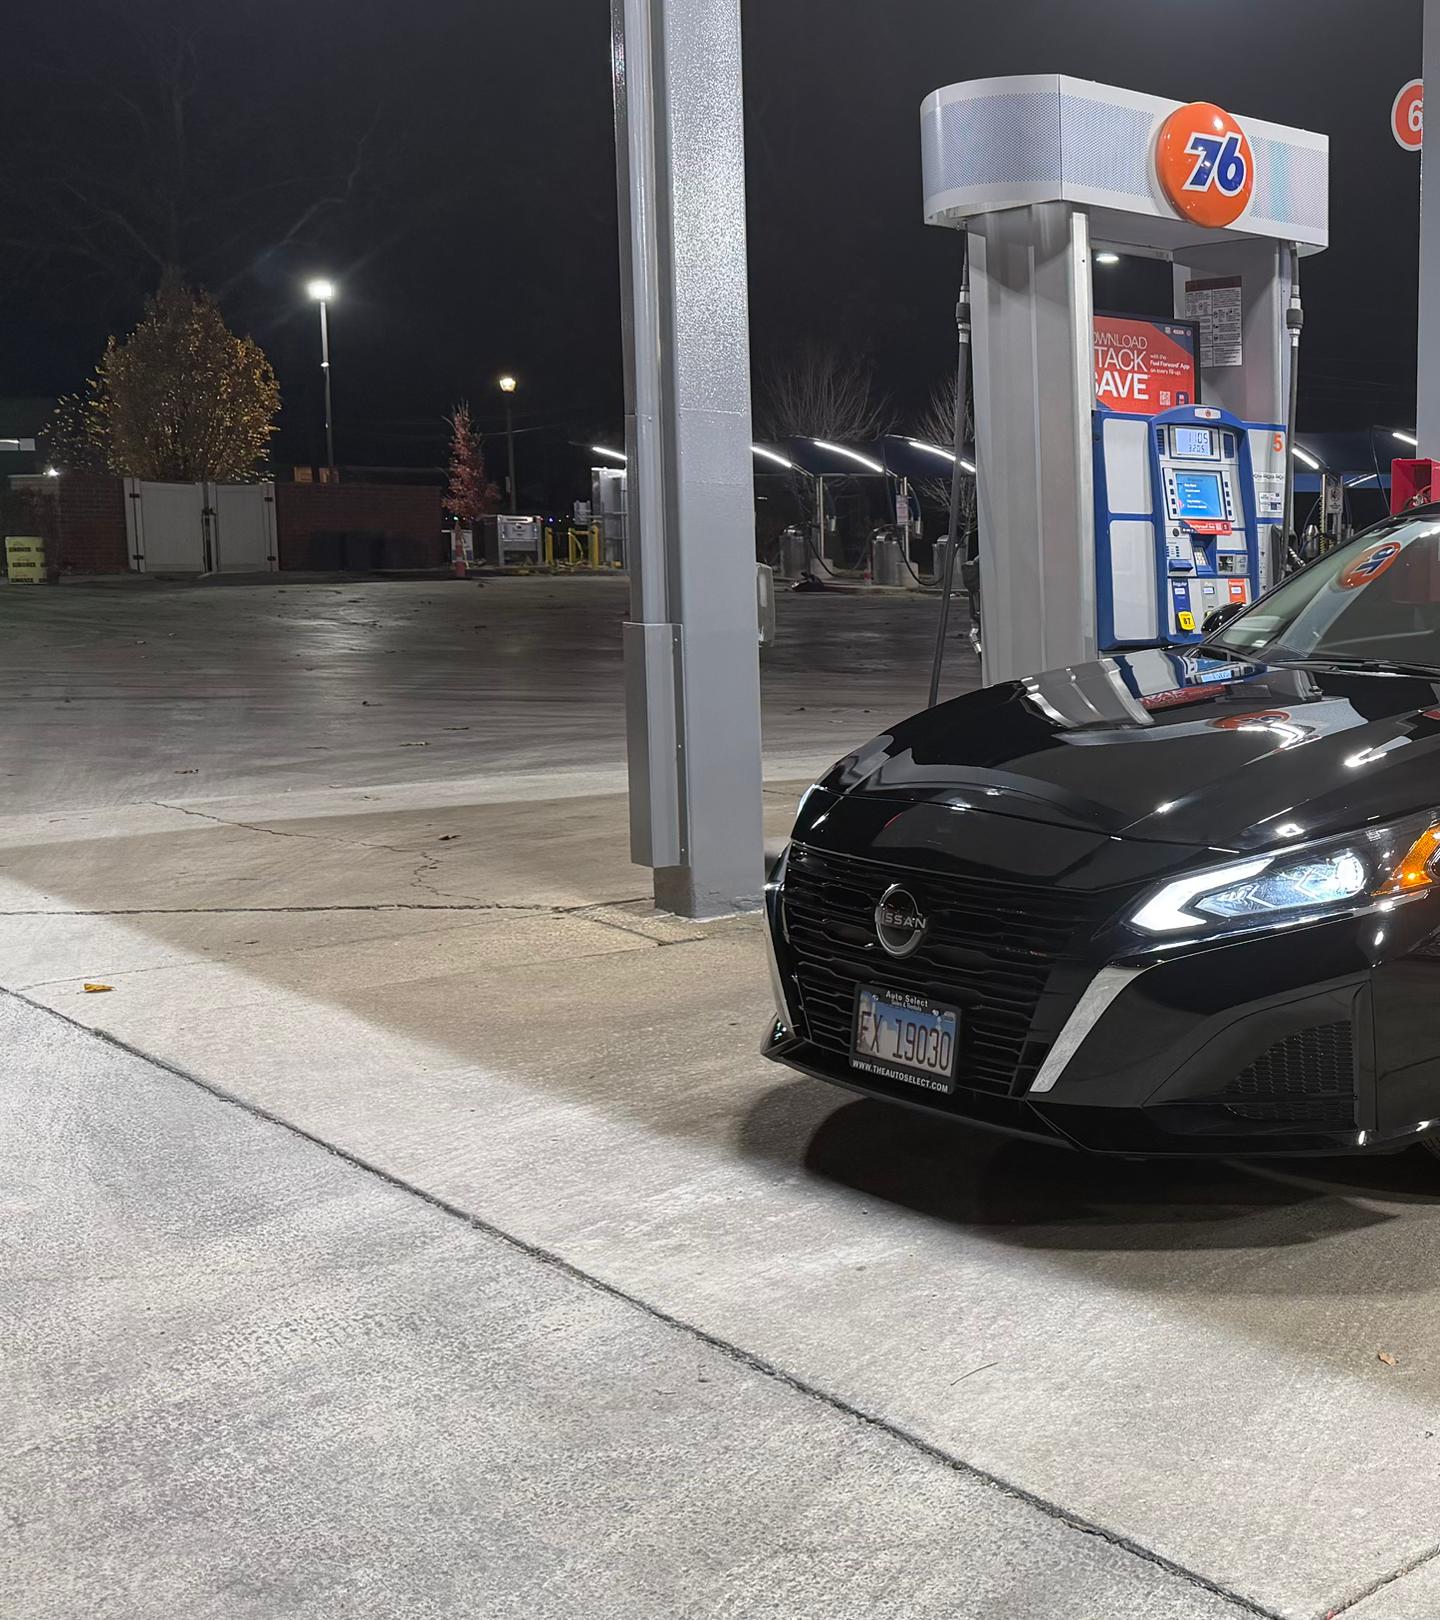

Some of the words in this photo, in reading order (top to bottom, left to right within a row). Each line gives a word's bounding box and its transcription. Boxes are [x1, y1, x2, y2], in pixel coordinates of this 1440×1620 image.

[1408, 99, 1423, 132] 6
[1181, 131, 1247, 197] 76
[1094, 332, 1147, 350] WNLOAD
[1273, 434, 1283, 452] 5
[880, 910, 927, 929] ISSAN
[885, 990, 902, 1002] Auto
[904, 994, 929, 1008] Select
[892, 1018, 952, 1072] 19030
[852, 1059, 949, 1093] WWW.THEAUTOSELECT.COM
